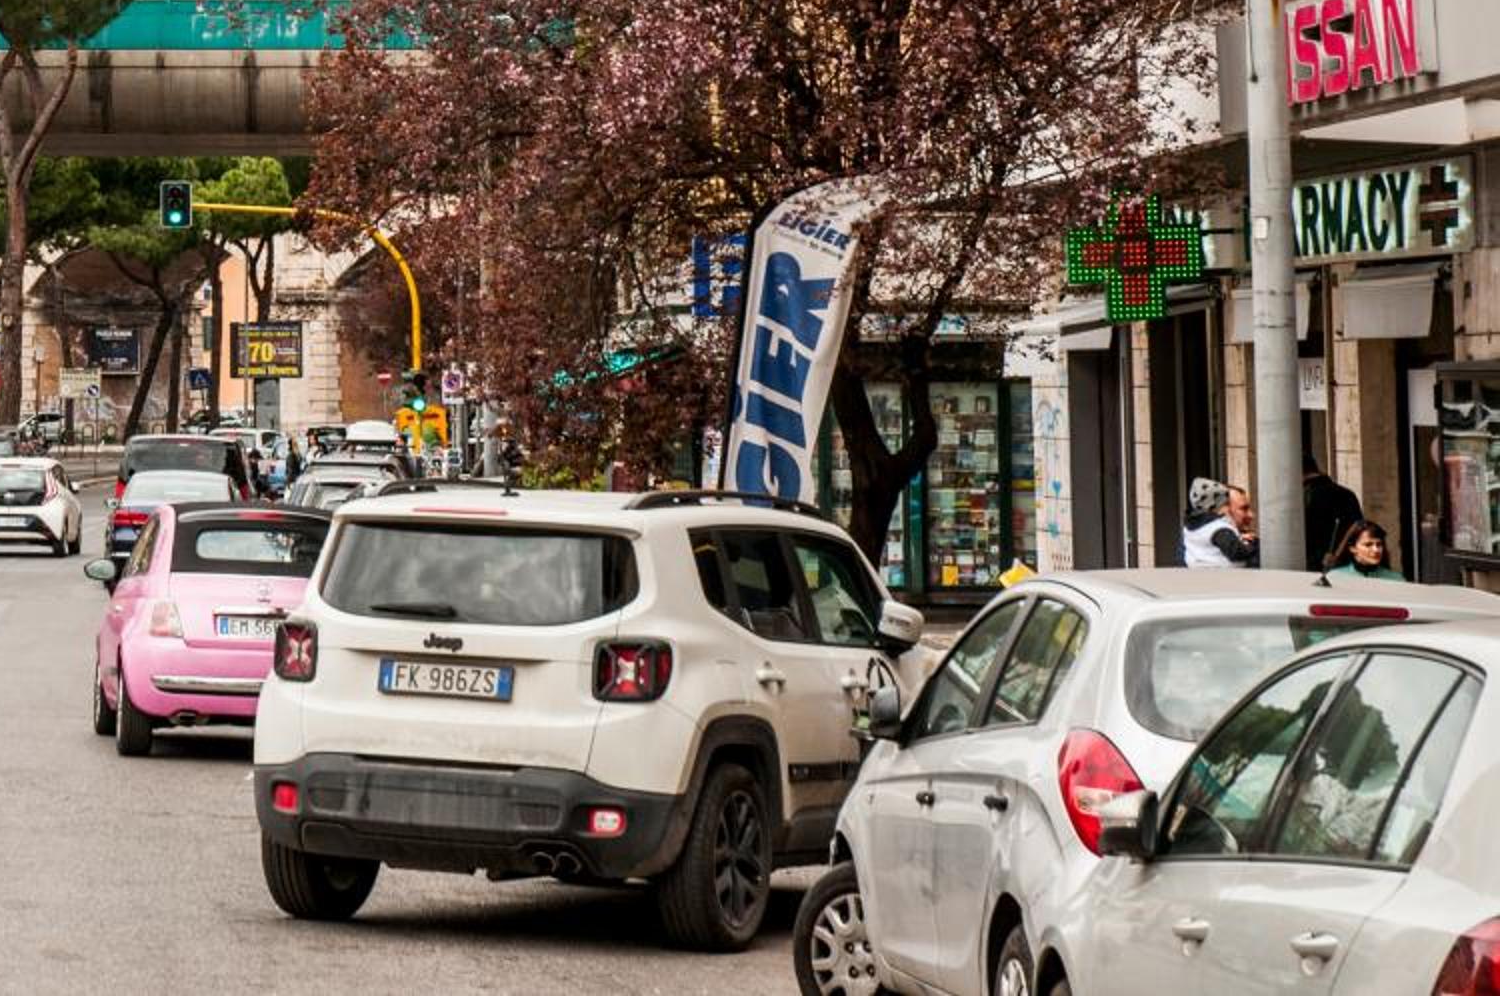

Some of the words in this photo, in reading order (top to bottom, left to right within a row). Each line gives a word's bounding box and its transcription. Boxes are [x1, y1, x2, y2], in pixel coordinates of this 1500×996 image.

[1290, 169, 1410, 258] RMACY
[734, 251, 837, 505] GIER
[422, 631, 464, 653] Jeep
[394, 663, 421, 689] FK
[428, 667, 496, 694] 986ZS
